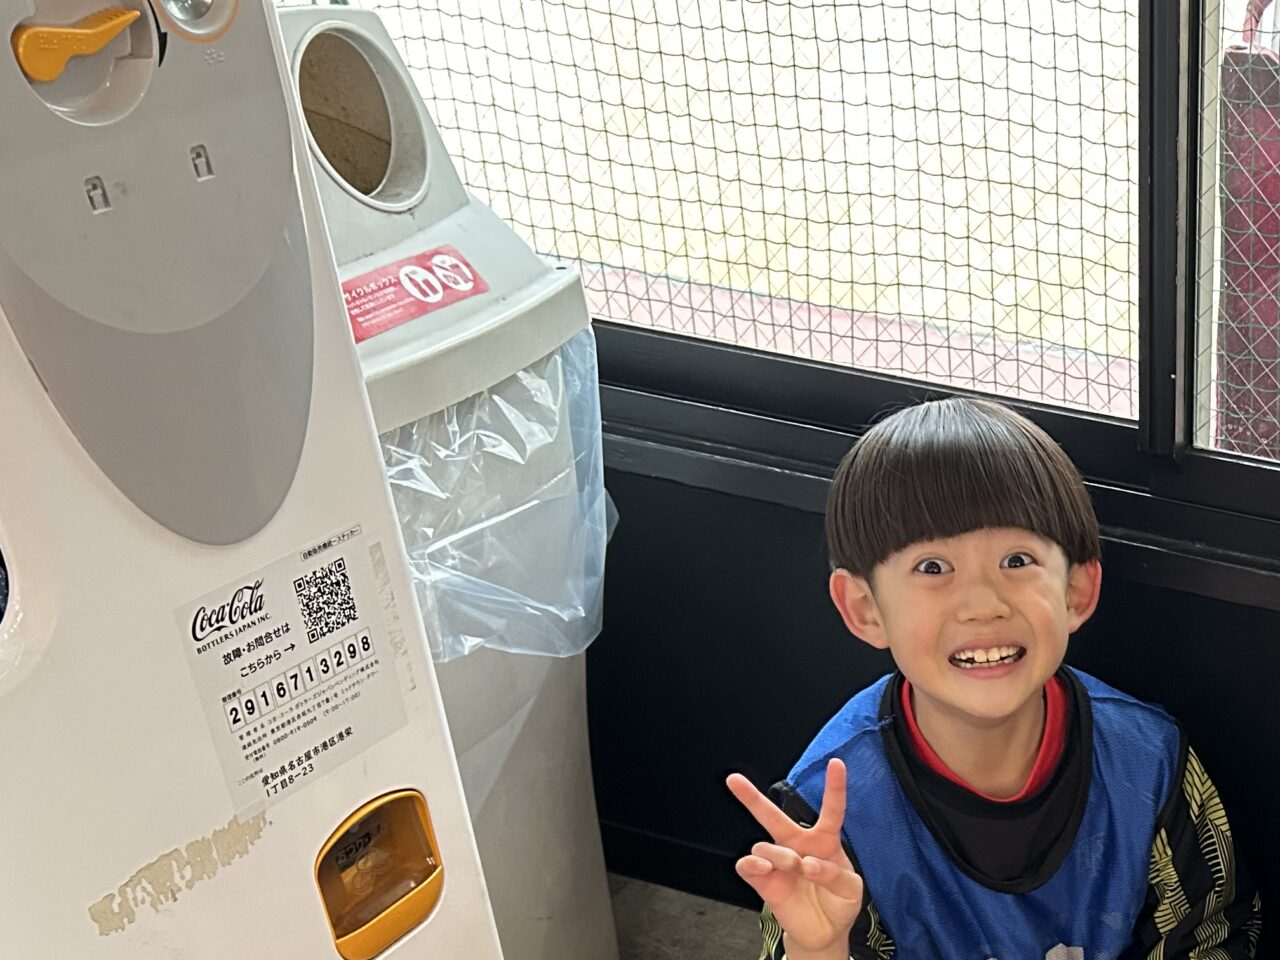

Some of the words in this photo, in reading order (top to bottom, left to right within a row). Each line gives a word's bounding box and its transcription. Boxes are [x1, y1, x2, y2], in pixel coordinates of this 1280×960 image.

[192, 578, 264, 642] Coca-Cola
[197, 631, 234, 654] BOTTLERS
[235, 620, 256, 636] JAPAN
[222, 622, 290, 665] 故障・お問合せは
[230, 636, 370, 725] 2916713298
[240, 650, 281, 677] こちらから
[262, 727, 352, 787] 愛知県名古屋市港区港栄
